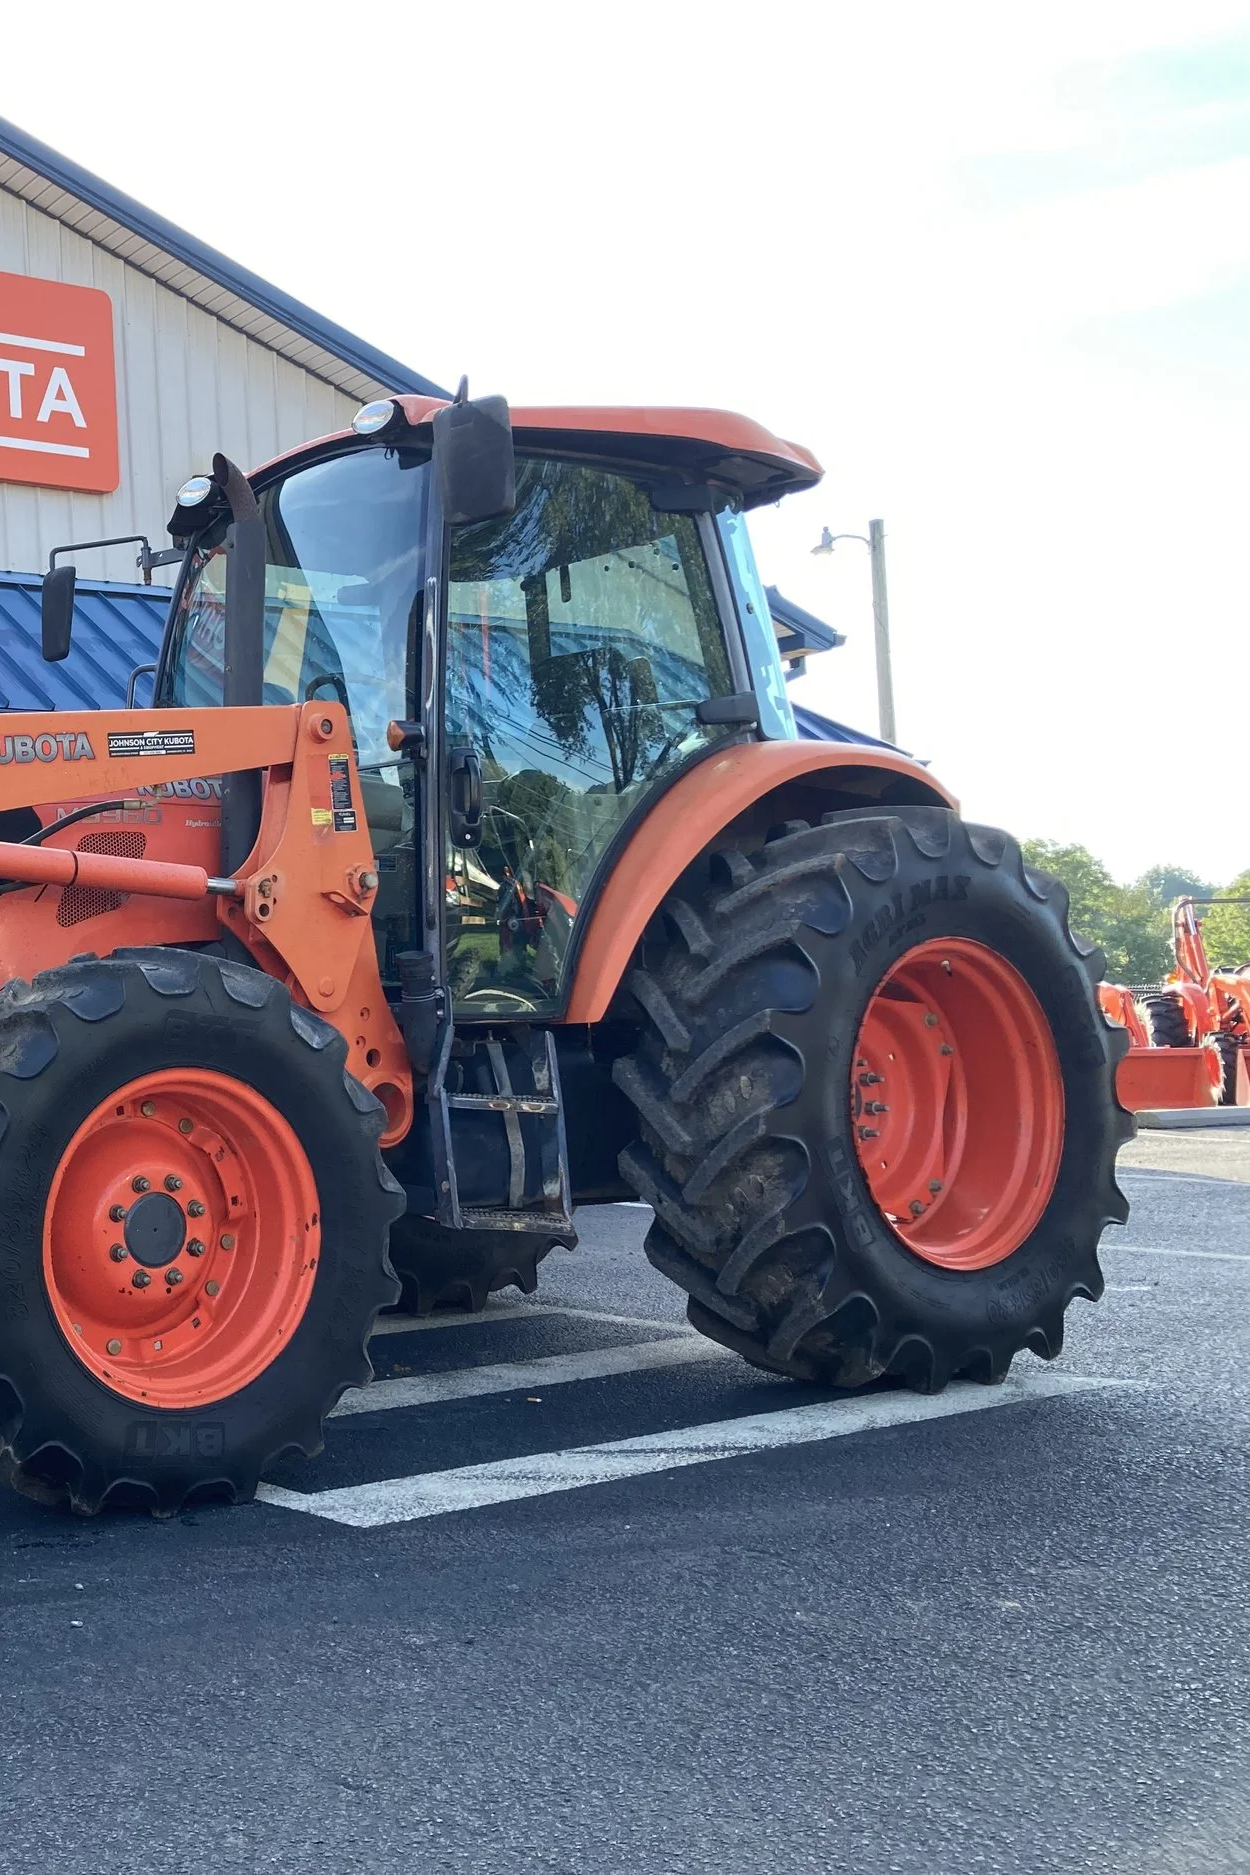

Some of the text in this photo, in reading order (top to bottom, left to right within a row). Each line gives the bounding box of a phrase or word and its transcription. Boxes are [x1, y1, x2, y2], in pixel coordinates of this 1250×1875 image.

[109, 738, 145, 747] JOHNSON
[163, 737, 194, 745] KUBOTA
[127, 1423, 225, 1457] BKT
